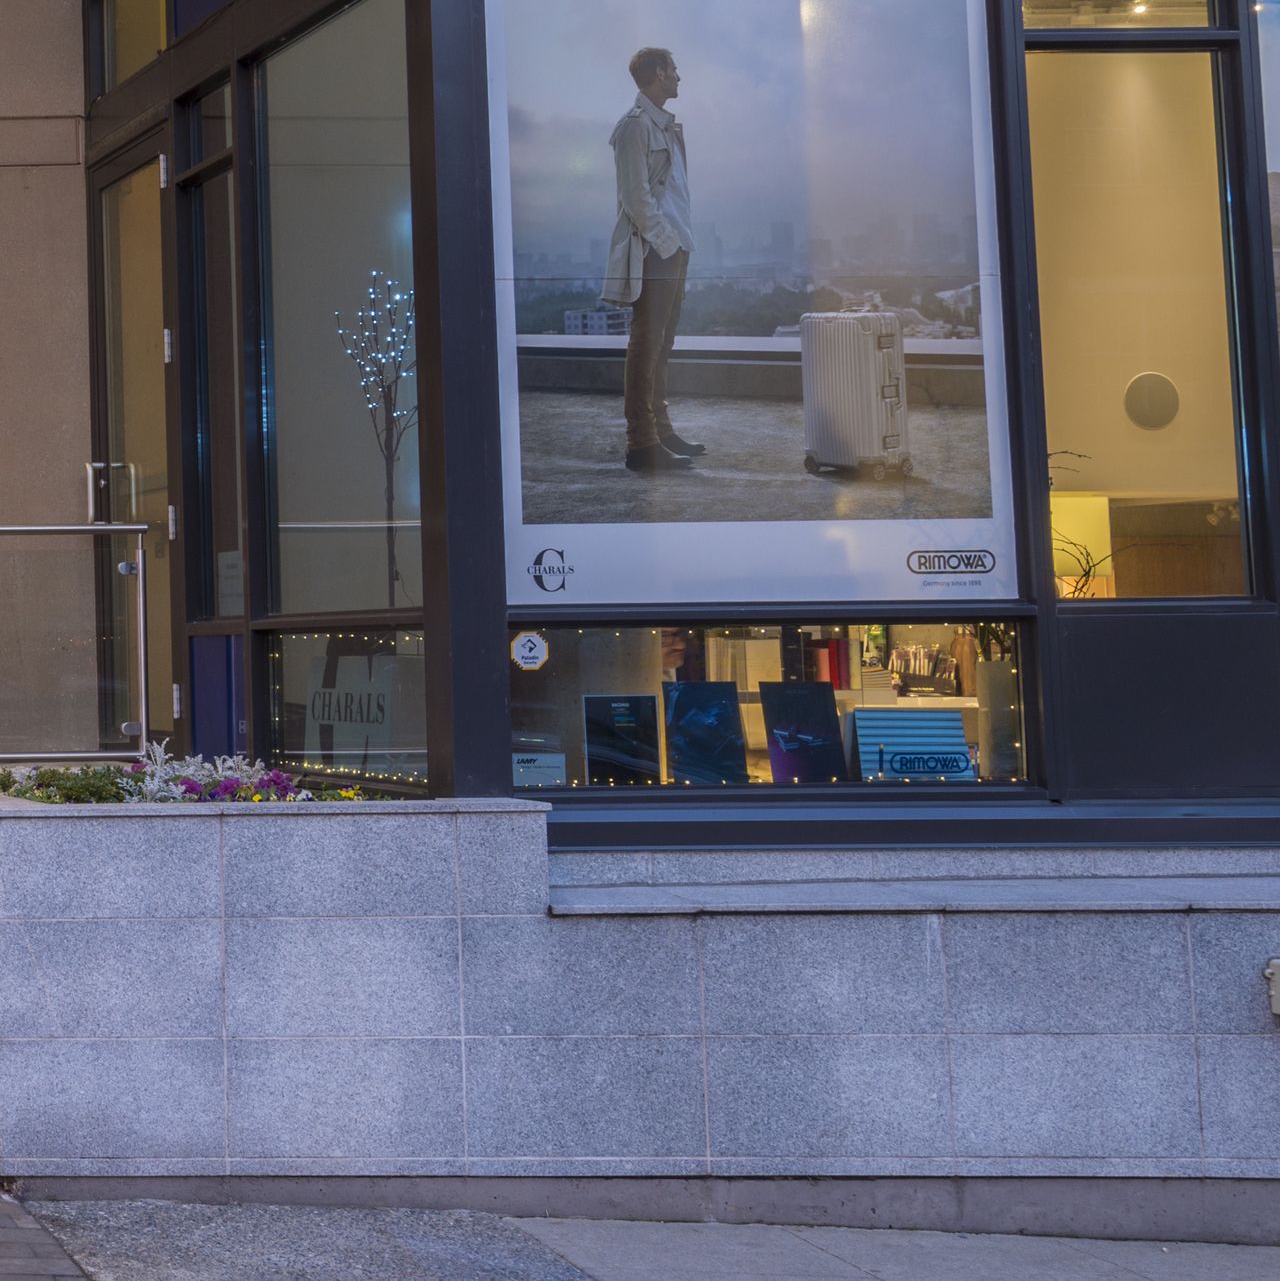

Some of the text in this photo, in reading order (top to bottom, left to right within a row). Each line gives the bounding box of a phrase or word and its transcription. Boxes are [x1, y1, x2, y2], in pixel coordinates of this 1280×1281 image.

[526, 565, 575, 575] CHARALS
[917, 553, 987, 571] RIMOWA
[922, 580, 950, 588] Germany
[311, 690, 386, 726] CHARALS
[899, 755, 961, 771] RIMOWA
